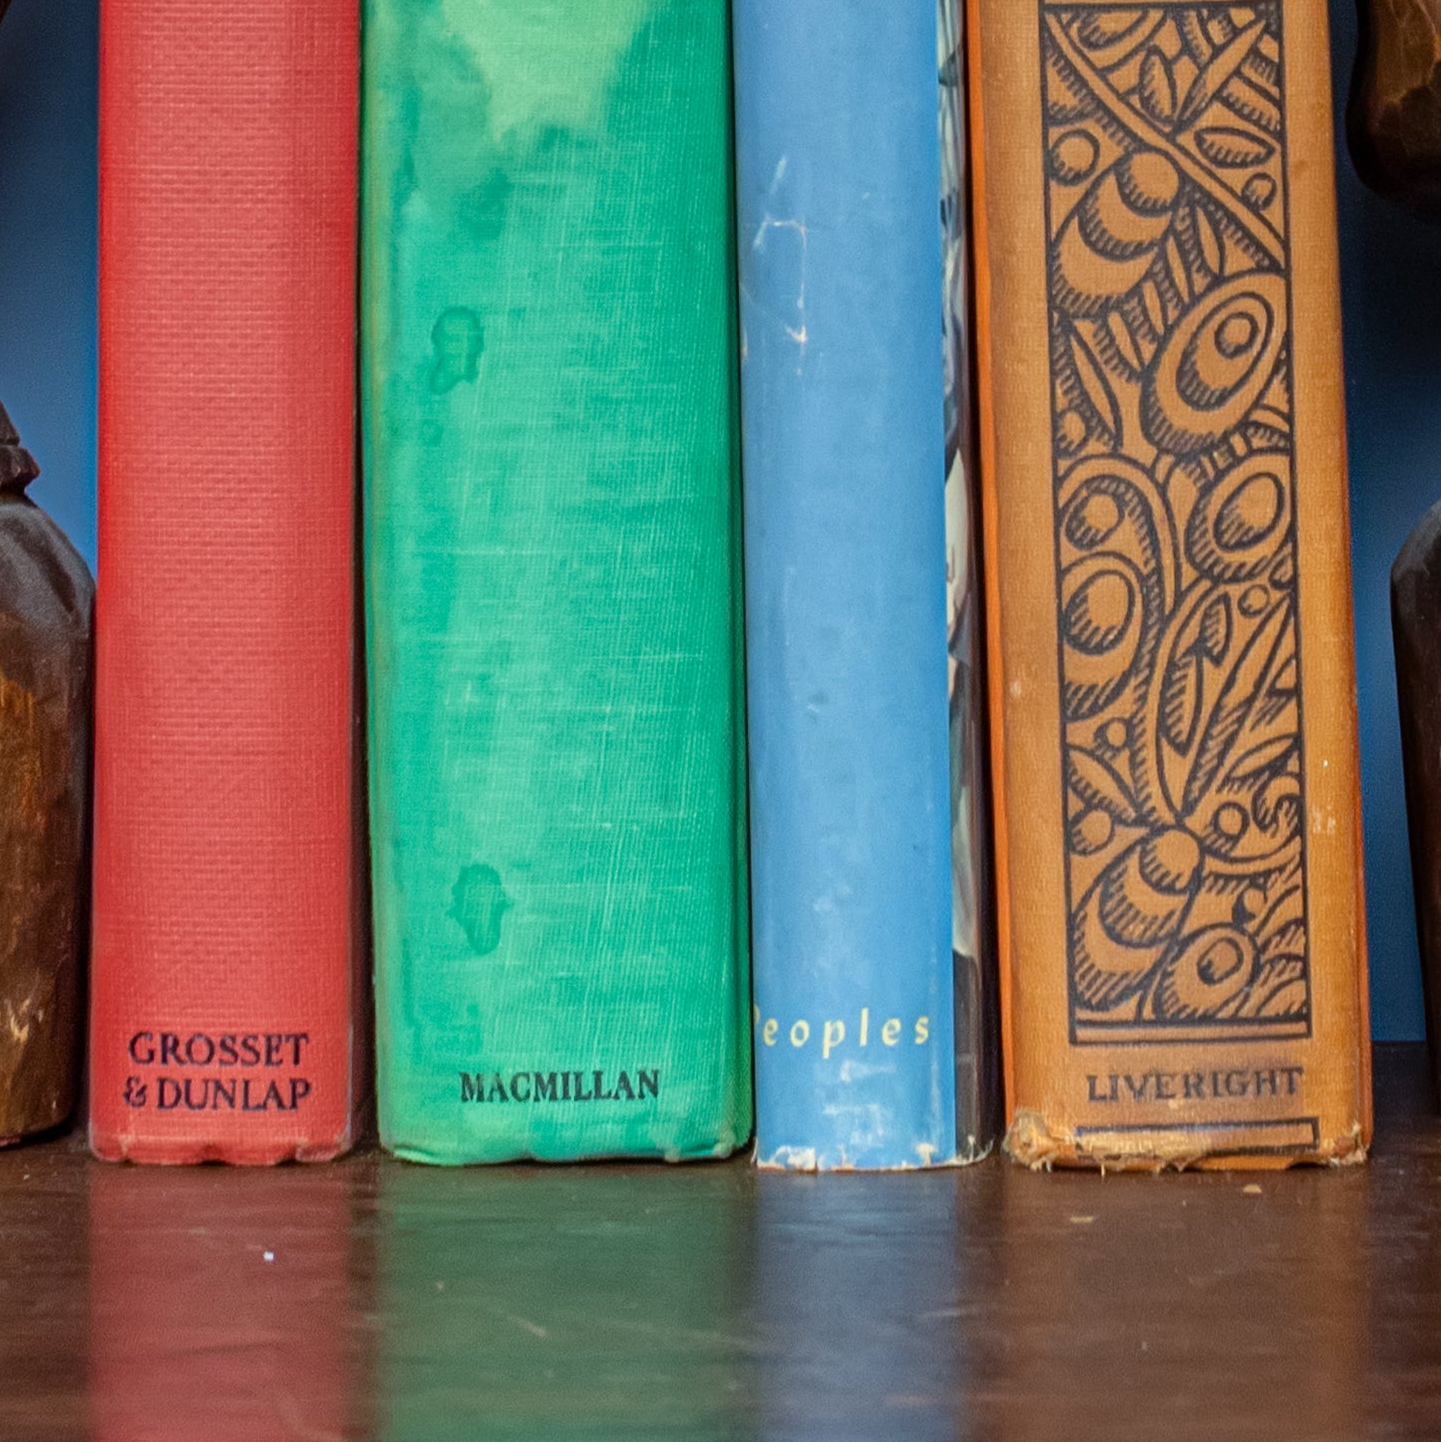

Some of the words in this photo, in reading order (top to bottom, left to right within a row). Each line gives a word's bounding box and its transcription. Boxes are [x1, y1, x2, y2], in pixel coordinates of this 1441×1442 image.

[127, 1031, 311, 1068] GROSSET
[752, 1003, 931, 1061] eoples
[121, 1075, 148, 1109] &
[156, 1076, 313, 1113] DUNLAP
[459, 1067, 661, 1105] MACMILLAN
[1086, 1064, 1306, 1105] LIVERIGHT
